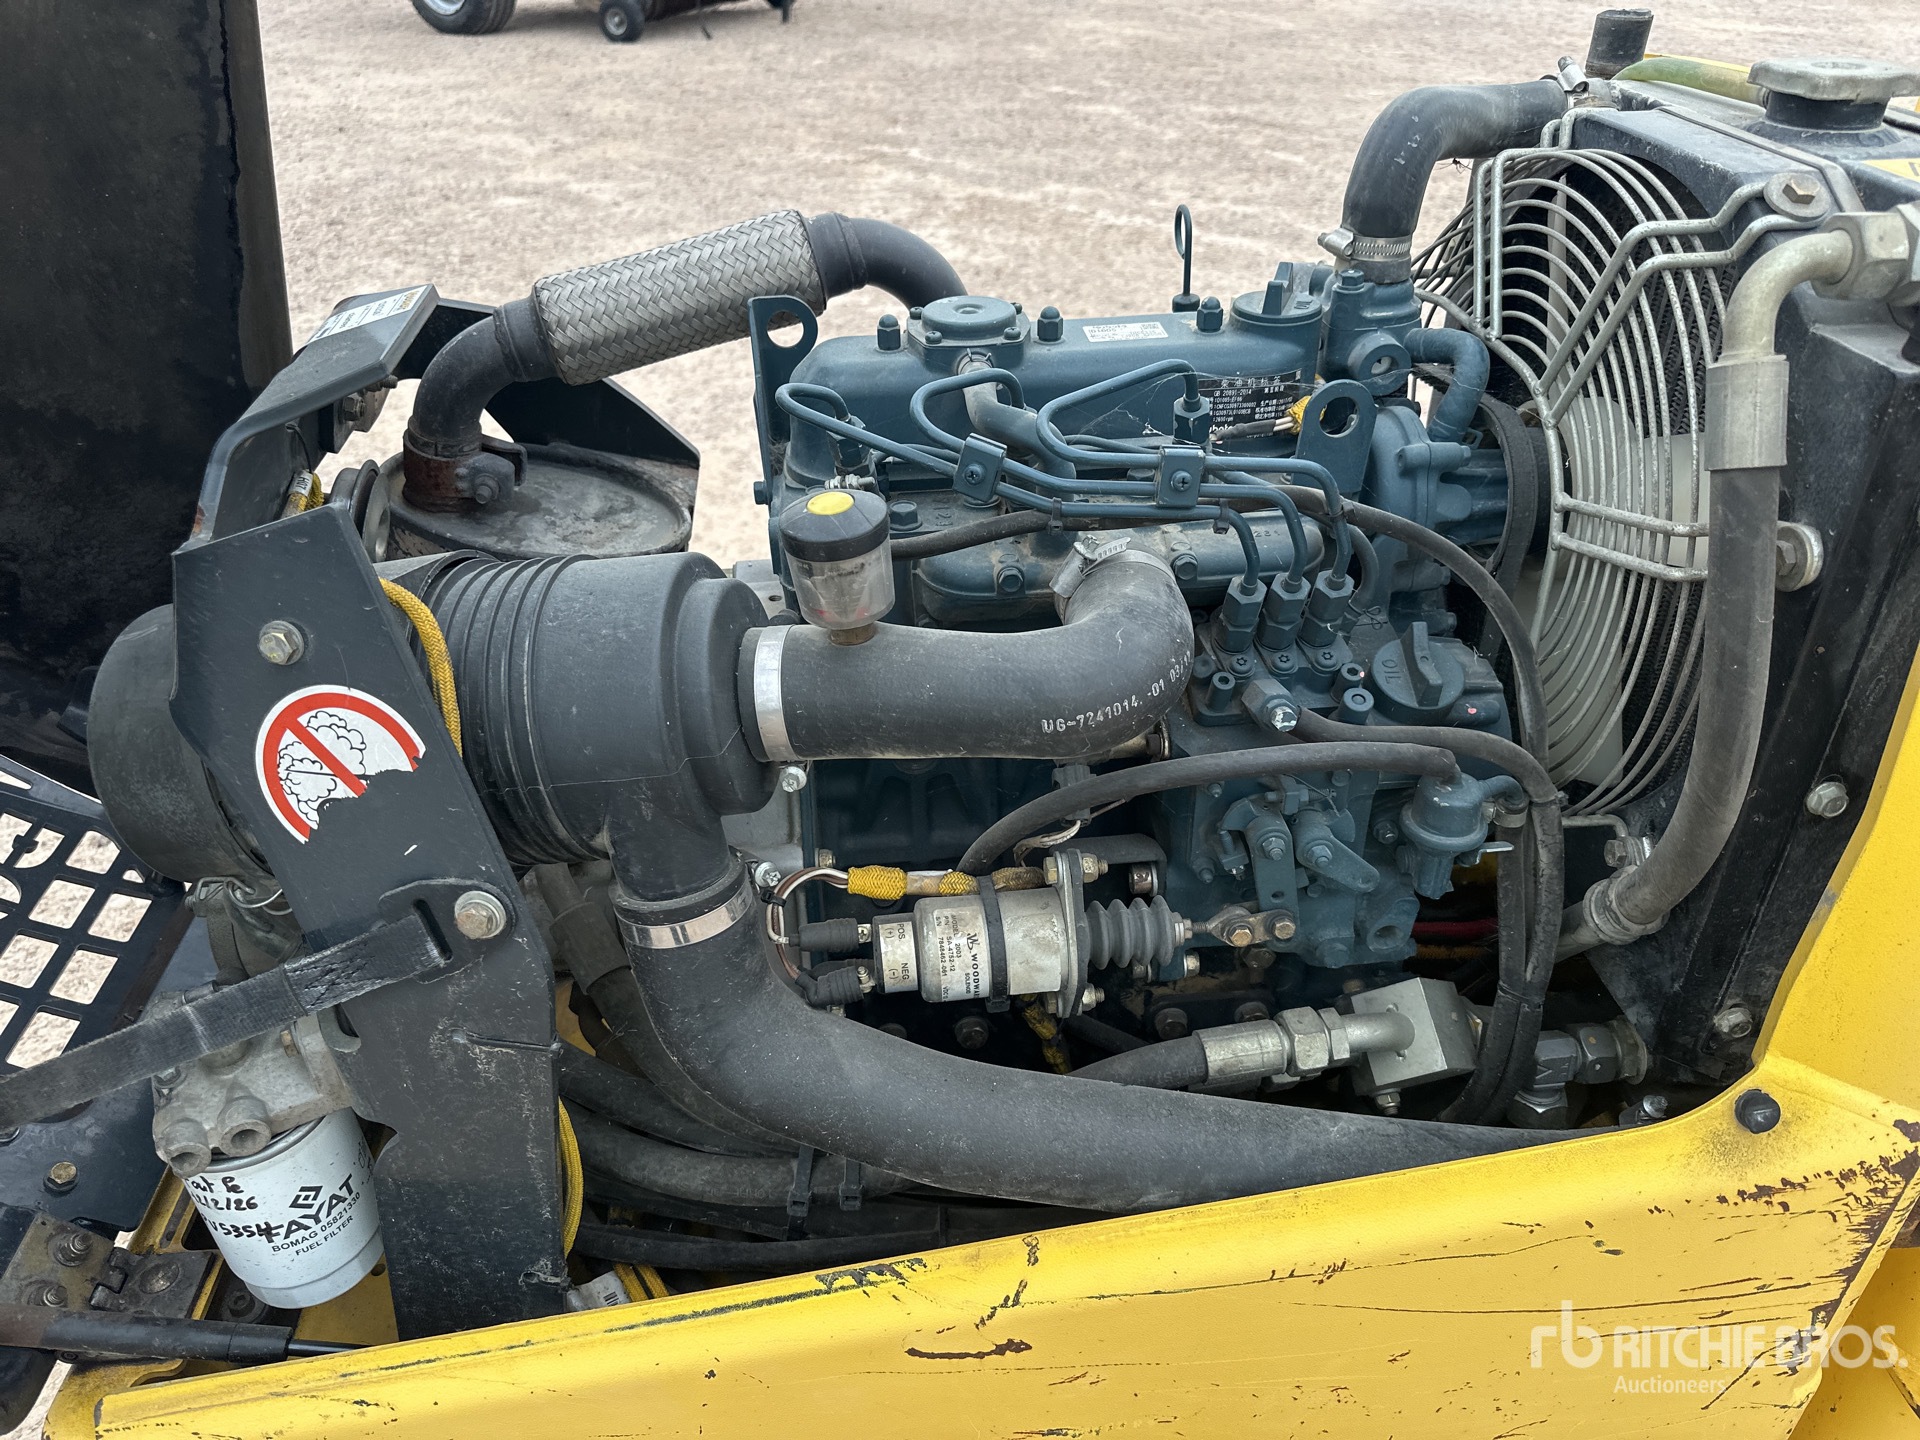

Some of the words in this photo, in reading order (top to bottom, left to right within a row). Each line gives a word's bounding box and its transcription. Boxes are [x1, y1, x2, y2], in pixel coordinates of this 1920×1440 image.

[1381, 659, 1402, 684] OIL
[950, 915, 959, 938] MODEL
[901, 962, 910, 980] NEG
[264, 1173, 354, 1244] FAYAT
[271, 1230, 318, 1252] BOMAG
[320, 1191, 361, 1232] 05821330
[295, 1241, 323, 1256] FUEL
[323, 1215, 354, 1242] FILTER
